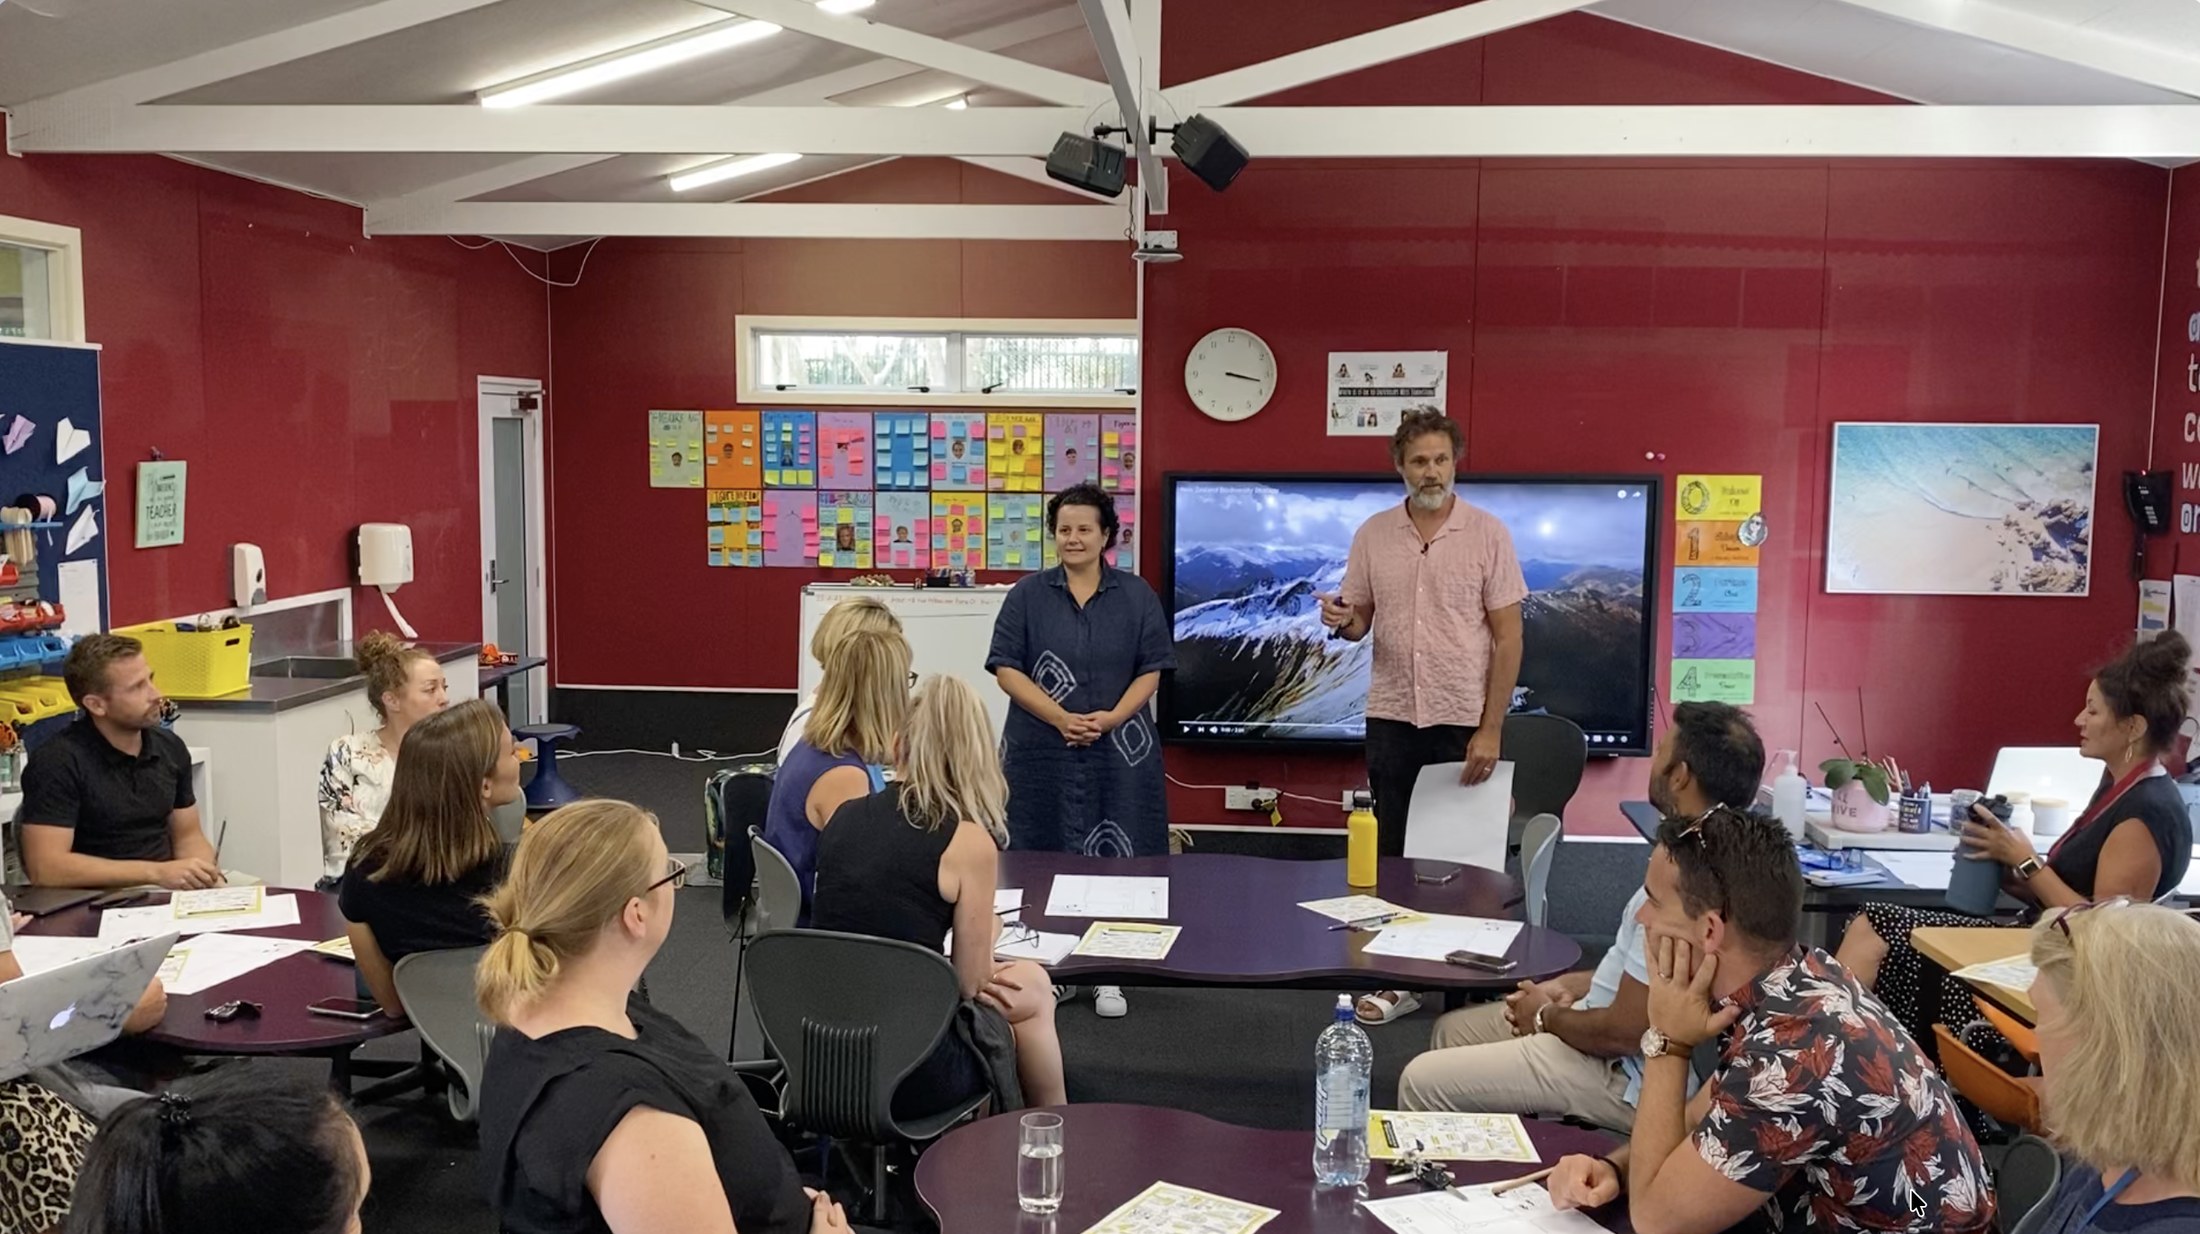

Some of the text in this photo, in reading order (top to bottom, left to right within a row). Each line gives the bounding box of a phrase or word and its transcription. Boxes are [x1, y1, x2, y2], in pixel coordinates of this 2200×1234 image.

[1259, 353, 1264, 361] 2
[1193, 370, 1198, 378] 9
[1227, 405, 1233, 413] 6
[1247, 401, 1252, 409] 5
[1681, 481, 1710, 515] 0
[146, 503, 177, 519] TEACHER
[1687, 527, 1699, 560] 1
[1681, 574, 1702, 606] 2
[1676, 666, 1702, 697] 4
